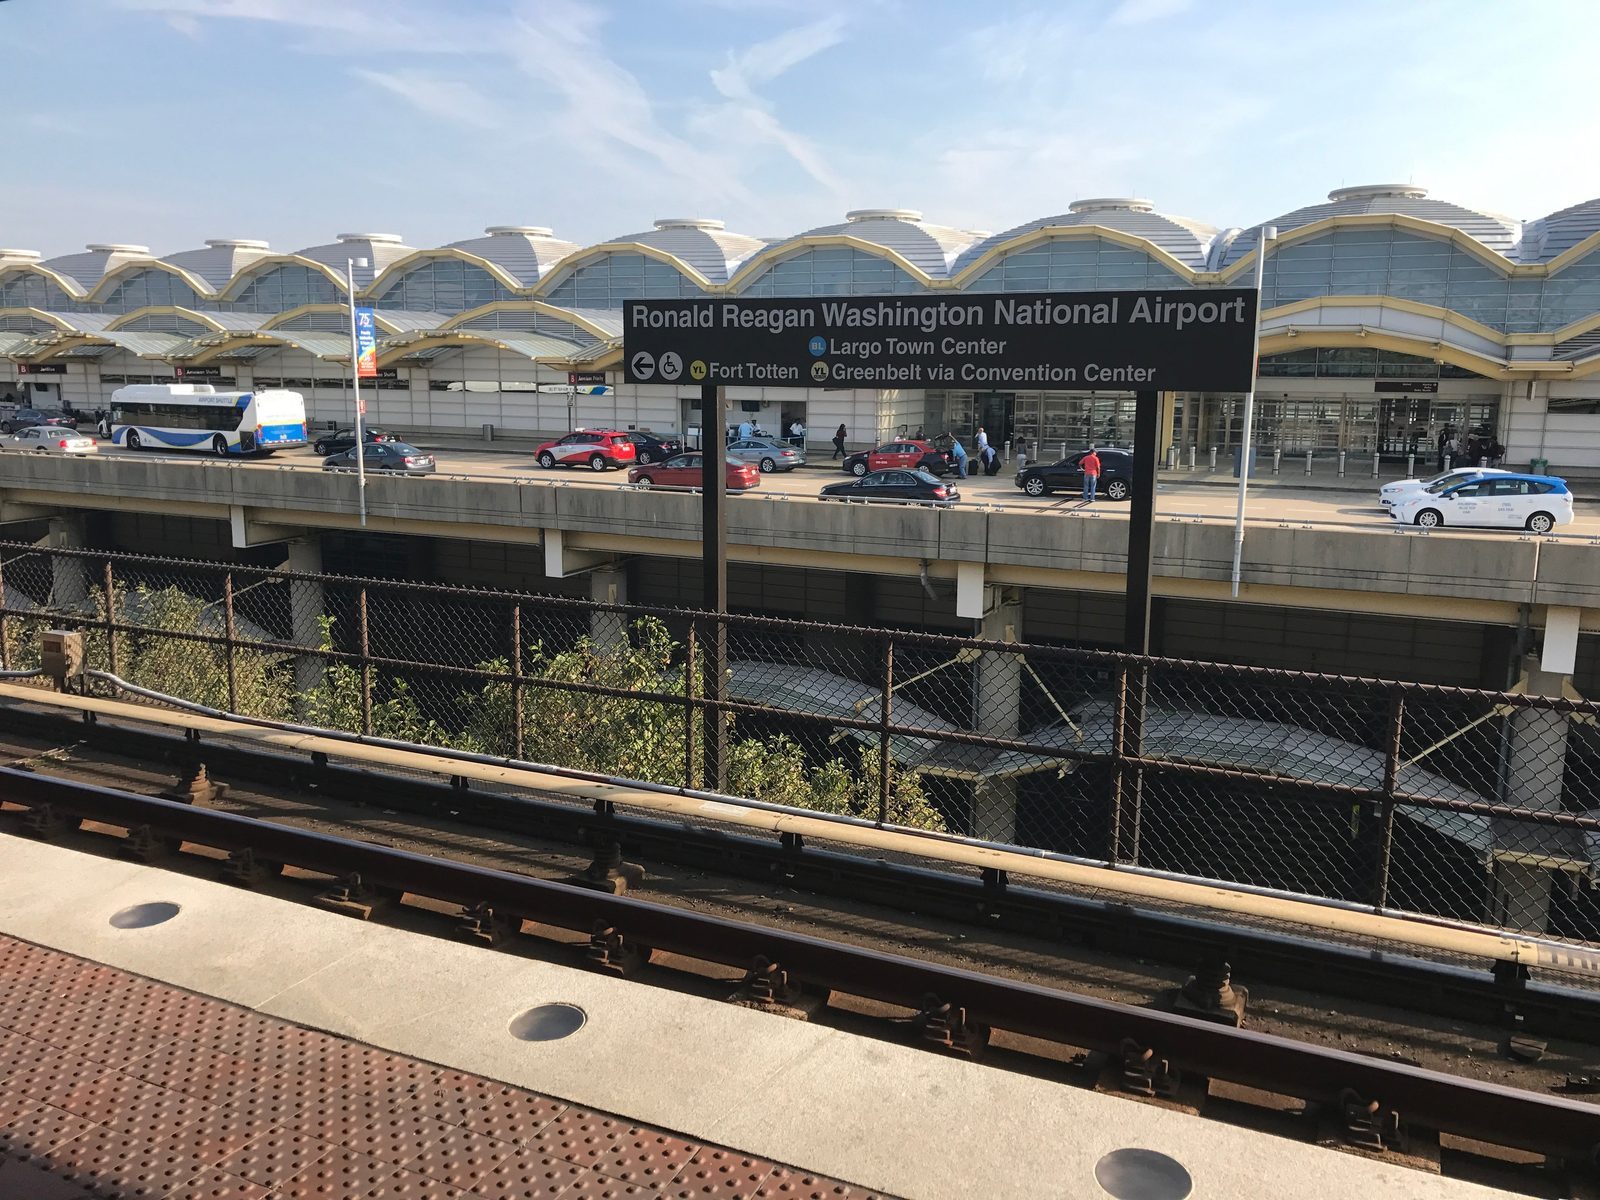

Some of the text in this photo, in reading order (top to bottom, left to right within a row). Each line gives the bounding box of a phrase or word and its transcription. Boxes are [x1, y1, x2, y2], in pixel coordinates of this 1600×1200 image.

[632, 296, 1245, 334] Ronald Reagan Washington National Airport
[811, 337, 1007, 357] BL Largo Town Center
[177, 368, 182, 376] B
[693, 362, 799, 379] YL Fort Totten
[832, 363, 921, 381] Greenbelt
[927, 363, 954, 381] via
[960, 363, 1076, 382] Convention
[1084, 363, 1156, 382] Center
